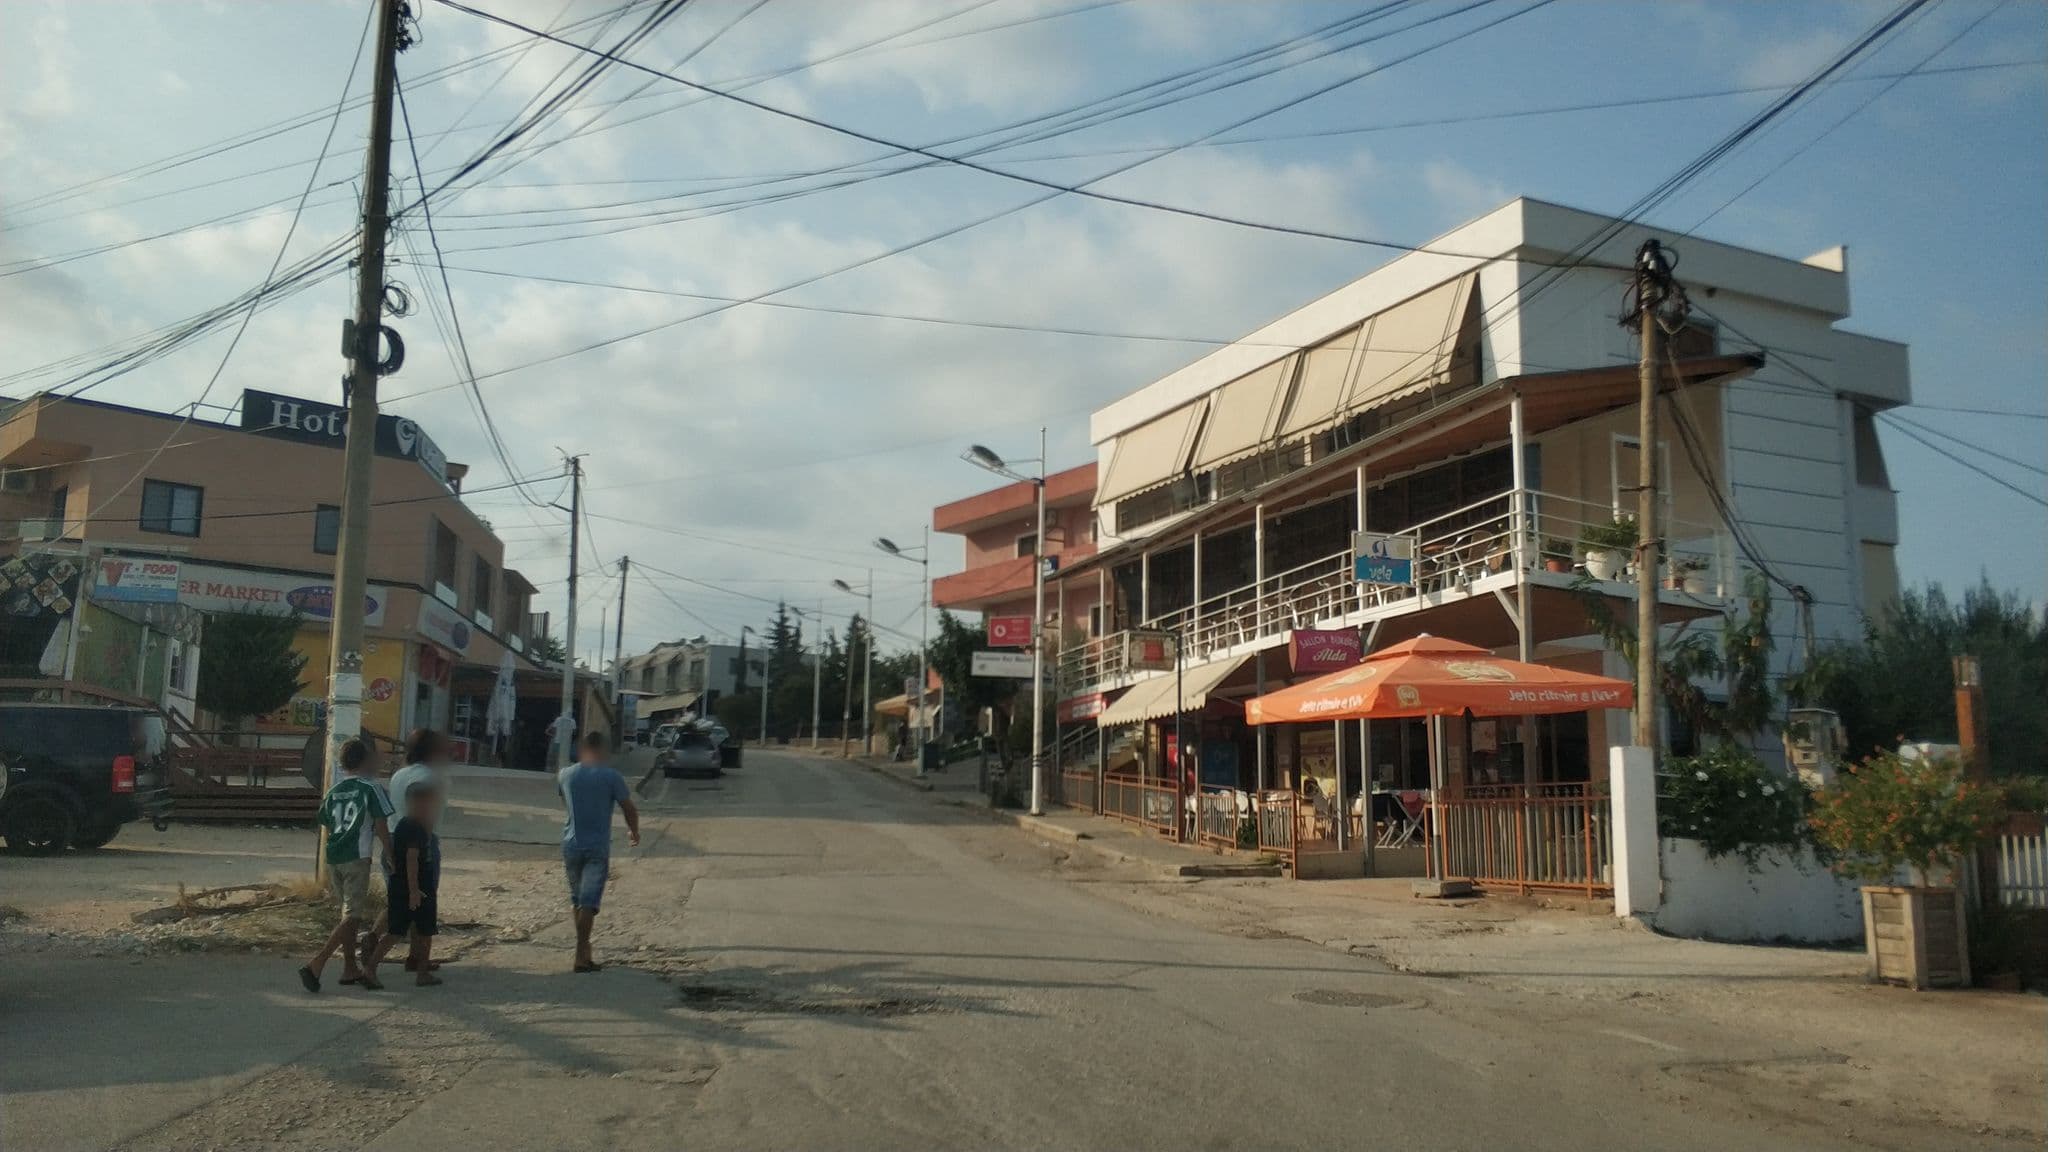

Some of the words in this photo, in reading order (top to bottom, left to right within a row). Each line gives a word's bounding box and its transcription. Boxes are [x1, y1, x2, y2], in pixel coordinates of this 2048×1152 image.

[271, 400, 350, 437] Hot
[142, 563, 177, 575] FOOD
[205, 582, 284, 602] MARKET
[1312, 647, 1347, 661] Alda
[1508, 690, 1535, 701] Jeto
[331, 801, 358, 834] 19
